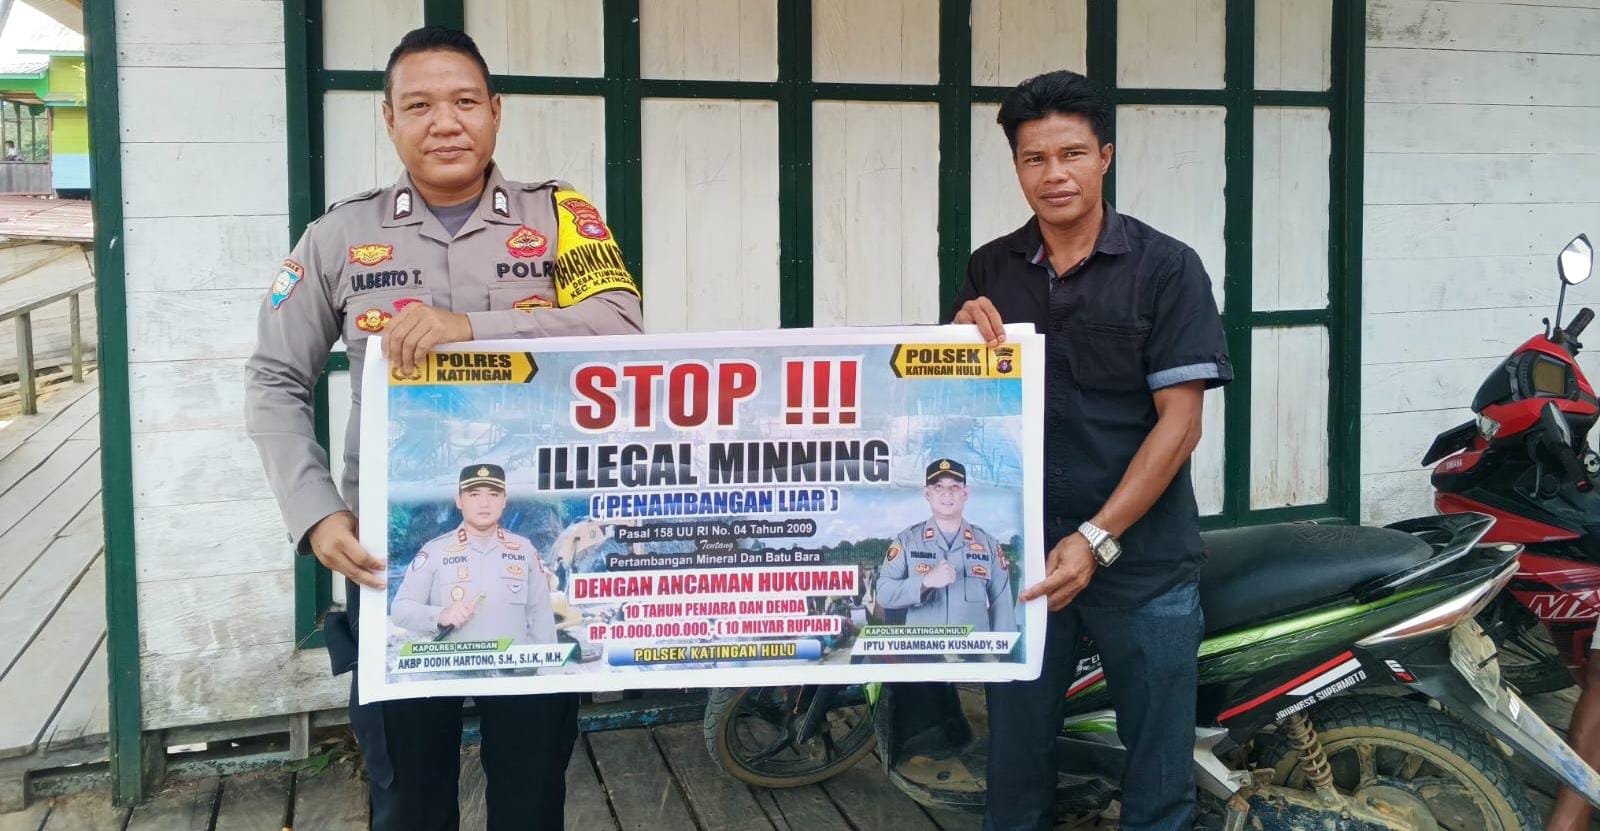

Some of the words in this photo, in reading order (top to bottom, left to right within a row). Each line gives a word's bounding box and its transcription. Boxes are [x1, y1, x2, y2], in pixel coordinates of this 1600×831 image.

[496, 261, 556, 278] POLR
[351, 270, 408, 292] ULBERTO
[412, 269, 423, 285] T.
[436, 353, 512, 368] POLRES
[906, 348, 981, 364] POLSEK
[436, 369, 512, 381] KATINGAN
[905, 365, 954, 376] KATINGAN
[956, 365, 982, 376] HULU
[574, 360, 758, 430] STOP
[537, 442, 698, 491] ILLEGAL
[708, 439, 890, 485] MINNING
[619, 529, 650, 539] Pasal
[654, 528, 673, 538] 158
[676, 527, 694, 537] UU
[697, 527, 709, 536] RI
[712, 526, 731, 536] No.
[733, 525, 748, 535] 04
[751, 525, 784, 535] Tahun
[787, 523, 813, 534] 2009
[700, 540, 735, 551] Tentang
[443, 555, 468, 565] DODIK
[501, 552, 525, 561] POLRI
[610, 556, 693, 568] Pertambangan
[697, 553, 737, 564] Mineral
[740, 552, 762, 563] Dan
[765, 552, 791, 563] Batu
[794, 551, 821, 562] Bara
[574, 576, 653, 599] DENGAN
[657, 573, 752, 596] ANCAMAN
[758, 571, 855, 593] HUKUMAN
[625, 604, 639, 619] 10
[643, 603, 682, 618] TAHUN
[686, 601, 736, 616] PENJARA
[739, 601, 763, 615] DAN
[766, 600, 806, 614] DENDA
[590, 626, 607, 640] RP.
[742, 619, 784, 634] MILYAR
[865, 627, 905, 636] KAPOLSEK
[906, 627, 945, 636] KATINGAN
[946, 626, 967, 635] HULU
[412, 643, 455, 653] KAPOLRES
[456, 641, 498, 651] KATINGAN
[634, 647, 687, 662] POLSEK
[690, 645, 757, 660] KATINGAN
[761, 643, 797, 657] HULU
[863, 640, 885, 651] IPTU
[887, 640, 946, 650] YUBAMBANG
[948, 640, 994, 651] KUSNADY,
[996, 640, 1009, 650] SH
[398, 658, 422, 670] AKBP
[424, 656, 450, 668] DODIK
[453, 655, 496, 667] HARTONO,
[545, 652, 563, 663] M.H.
